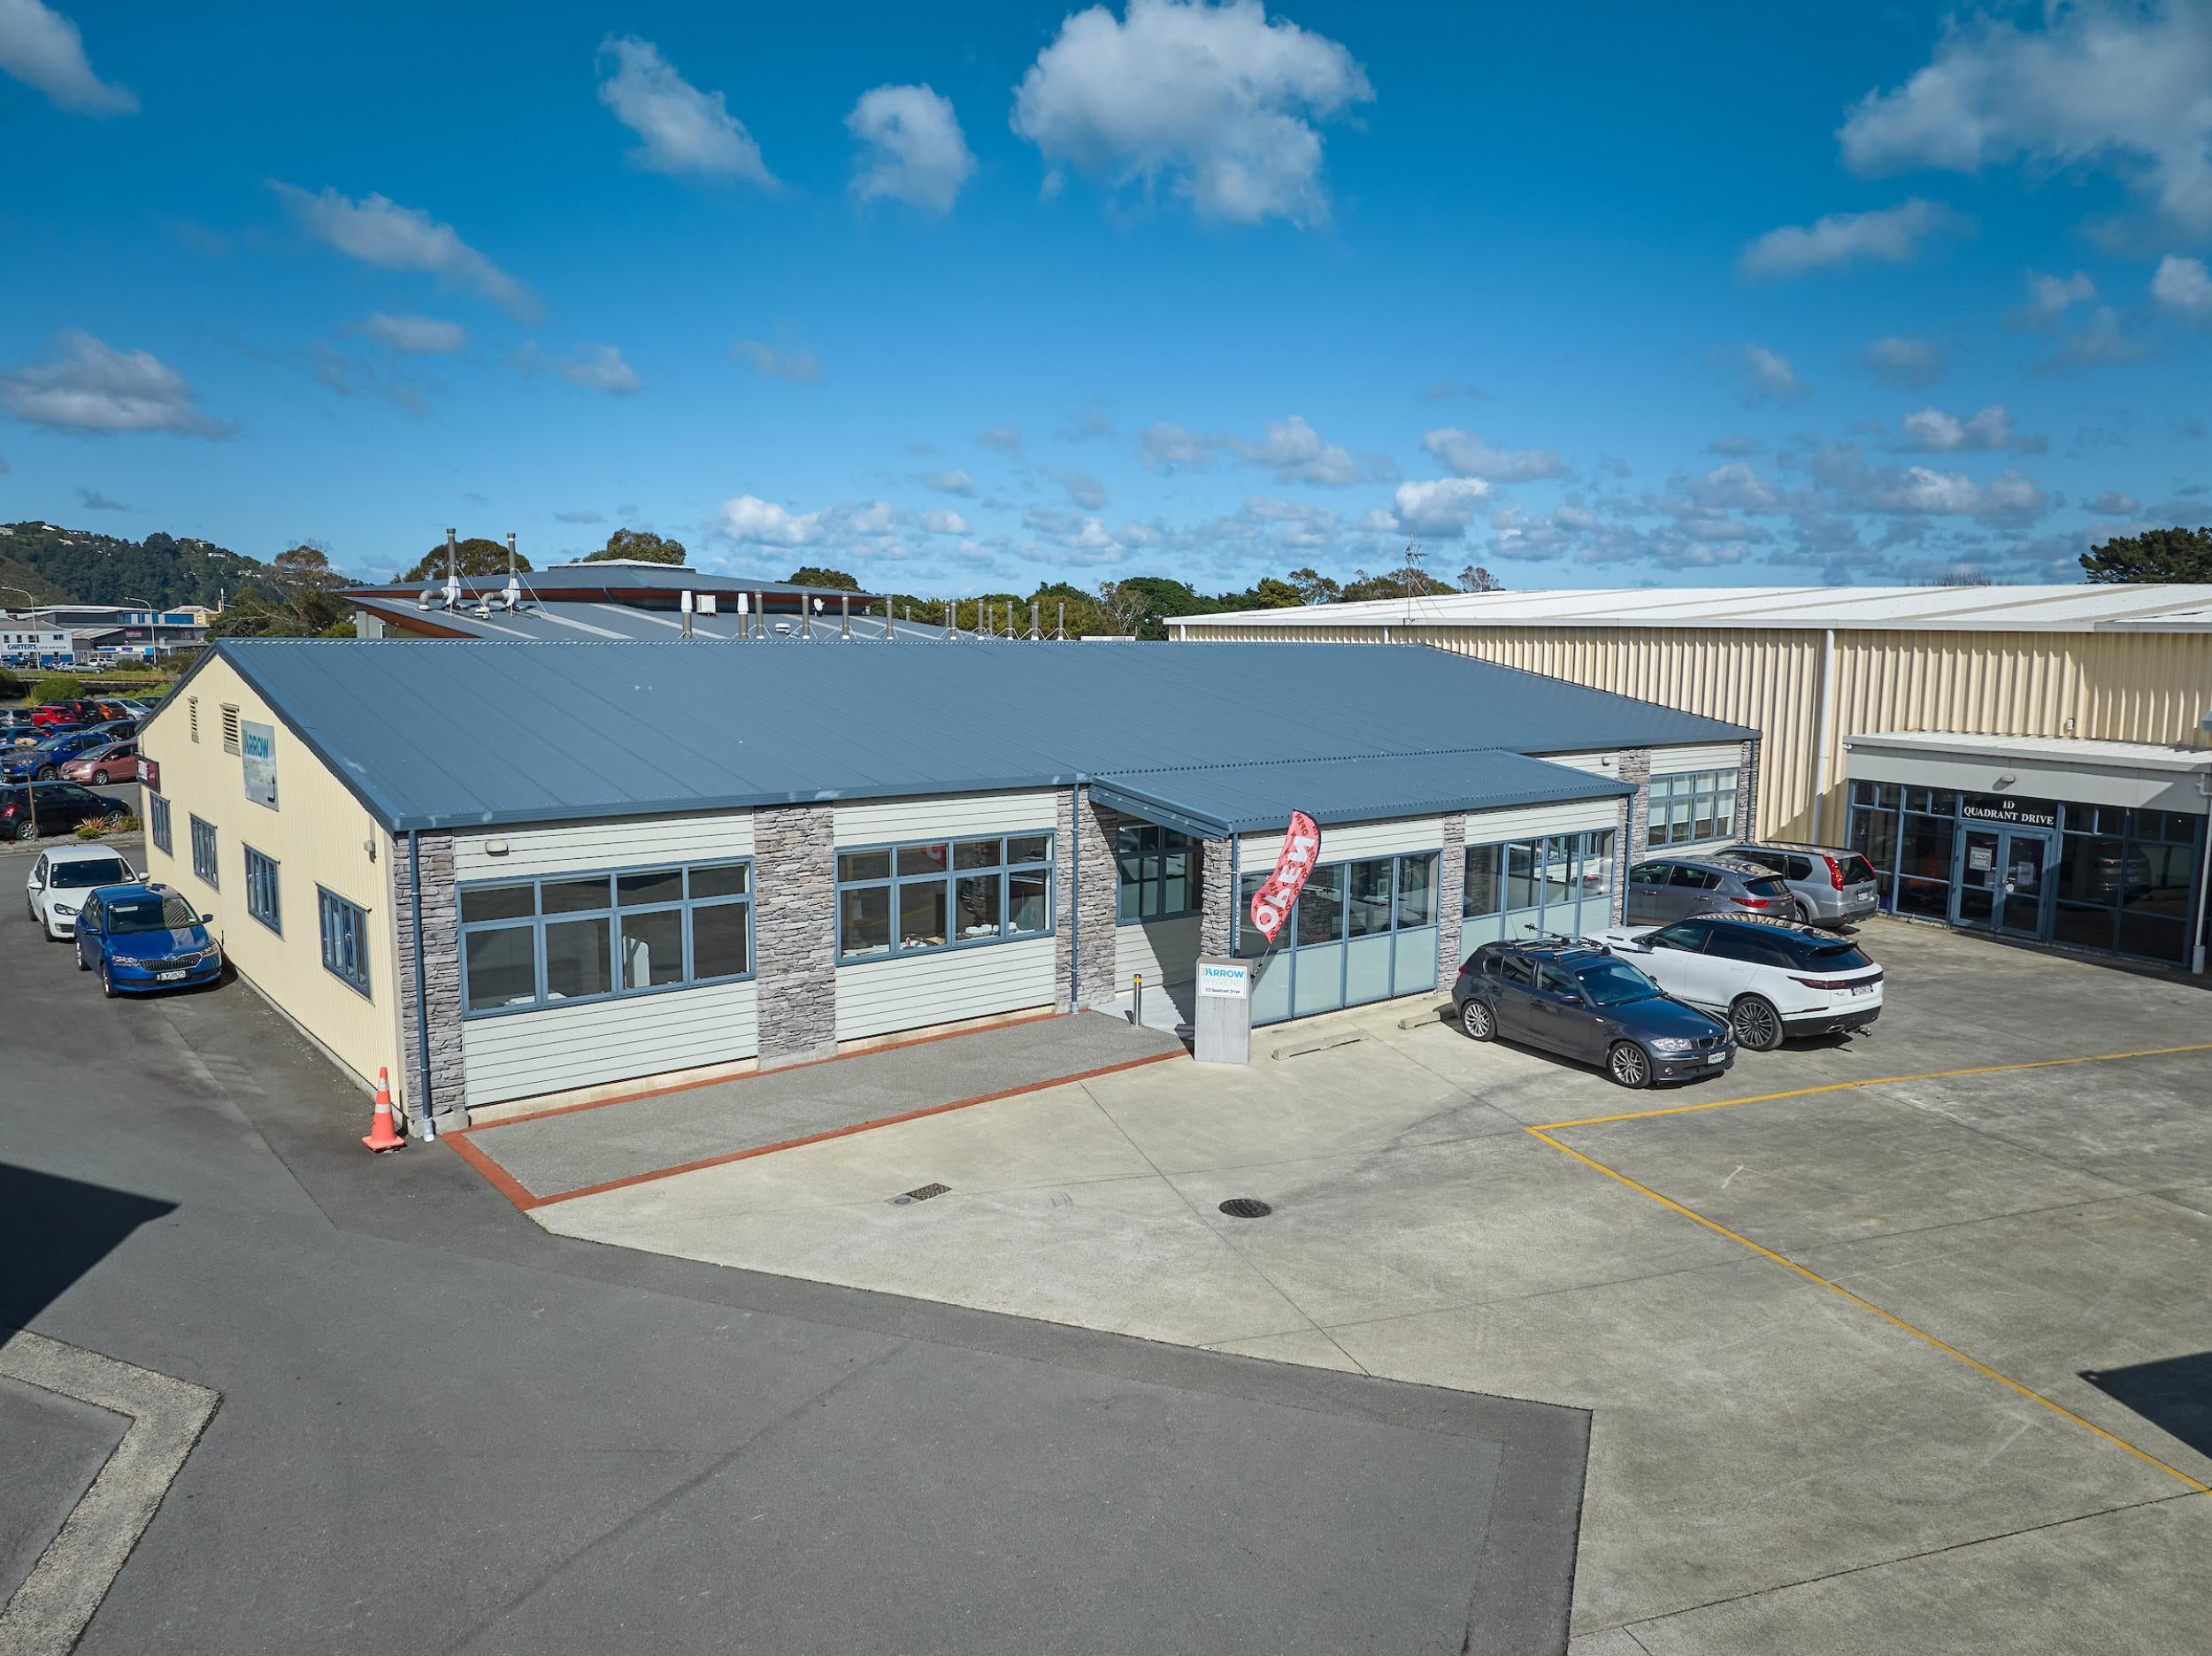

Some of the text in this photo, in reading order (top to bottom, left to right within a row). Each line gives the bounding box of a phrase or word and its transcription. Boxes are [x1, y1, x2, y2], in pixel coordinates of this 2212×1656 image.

[243, 731, 269, 759] ARROW
[2002, 801, 2015, 809] 1D
[1963, 806, 2055, 825] QUADRANT DRIVE
[1204, 968, 1243, 978] ARROW
